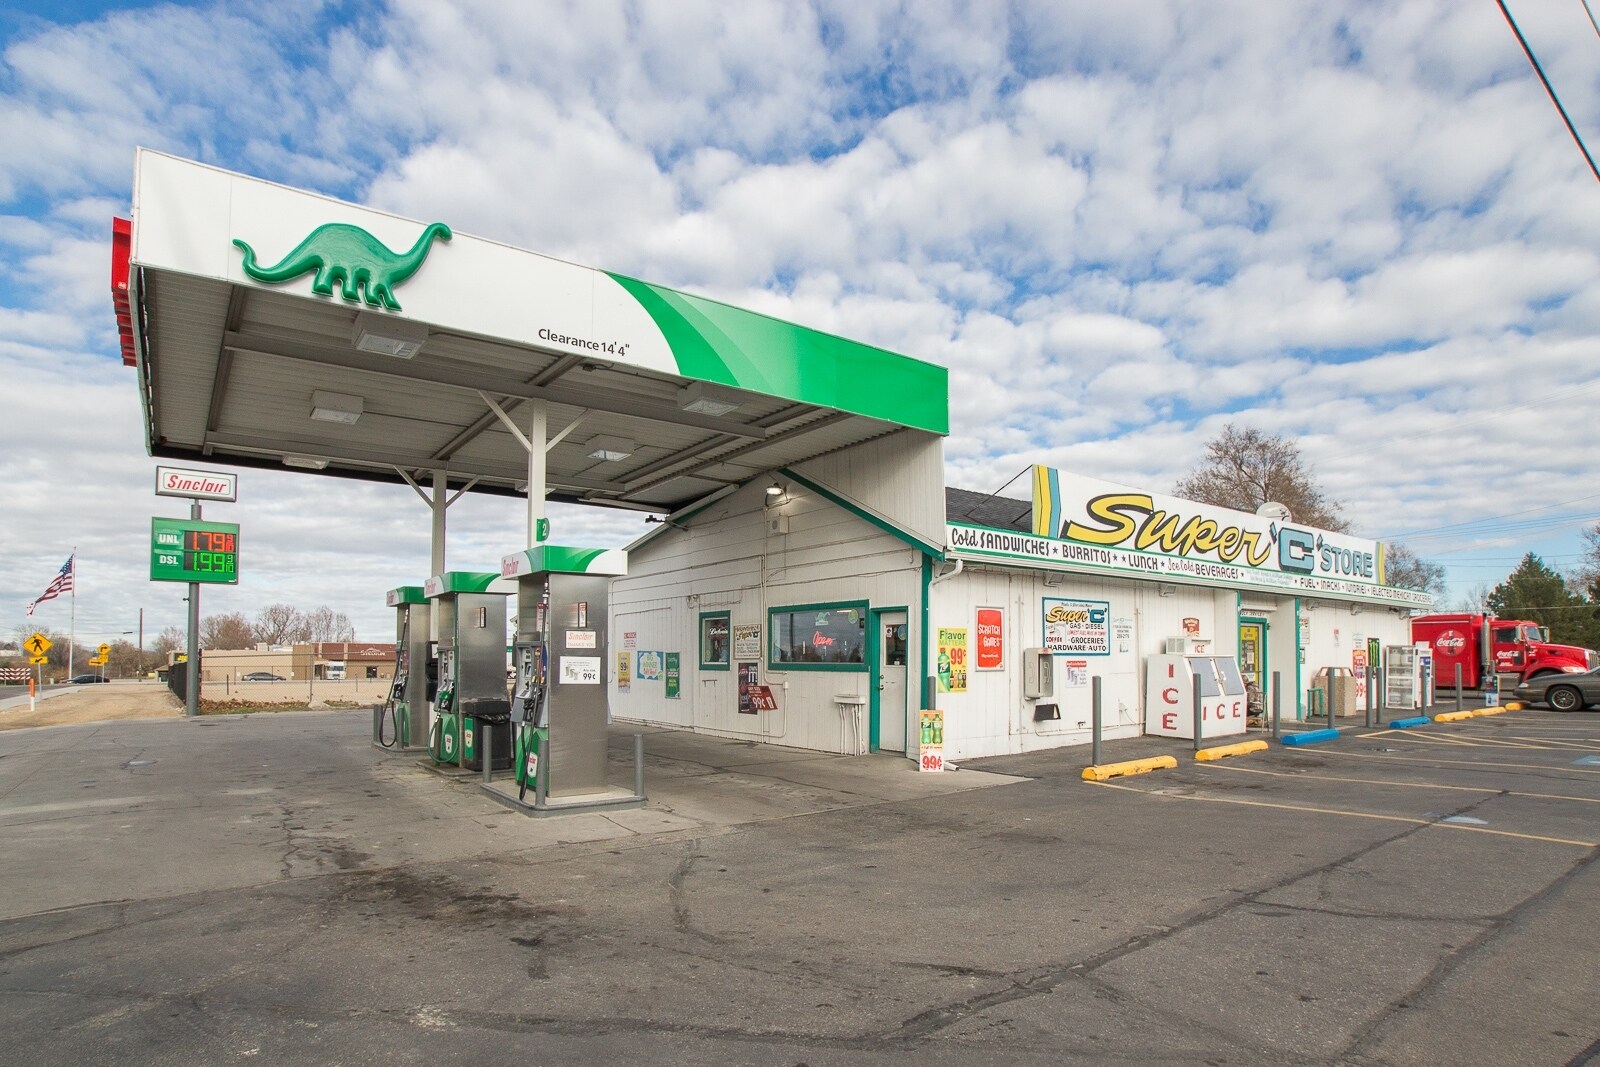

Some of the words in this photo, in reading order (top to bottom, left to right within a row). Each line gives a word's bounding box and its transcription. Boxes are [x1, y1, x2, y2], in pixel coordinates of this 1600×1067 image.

[538, 328, 600, 351] Clearance
[601, 341, 617, 354] 14'
[167, 474, 227, 493] Sinclair
[542, 523, 547, 537] 2
[1061, 493, 1271, 567] Super
[1320, 543, 1374, 578] STORE
[158, 533, 180, 544] UNL
[159, 555, 179, 565] DSL
[193, 552, 226, 573] 1.99
[951, 527, 978, 547] Cold
[980, 531, 1050, 556] SANDWICHES
[1062, 544, 1111, 565] BURRITOS
[1128, 554, 1158, 570] LUNCH
[1167, 558, 1180, 571] Ice
[1195, 564, 1239, 580] BEVERAGES
[1300, 577, 1316, 589] FUEL
[1045, 606, 1088, 625] Super
[568, 632, 593, 640] Sinclair
[939, 630, 966, 640] Flavor
[978, 623, 1001, 635] SCRATCH
[813, 631, 833, 647] Open
[983, 635, 1001, 647] GAMES
[1436, 637, 1465, 647] Coca-Cola
[1194, 644, 1205, 653] ICE
[1202, 701, 1241, 721] ICE
